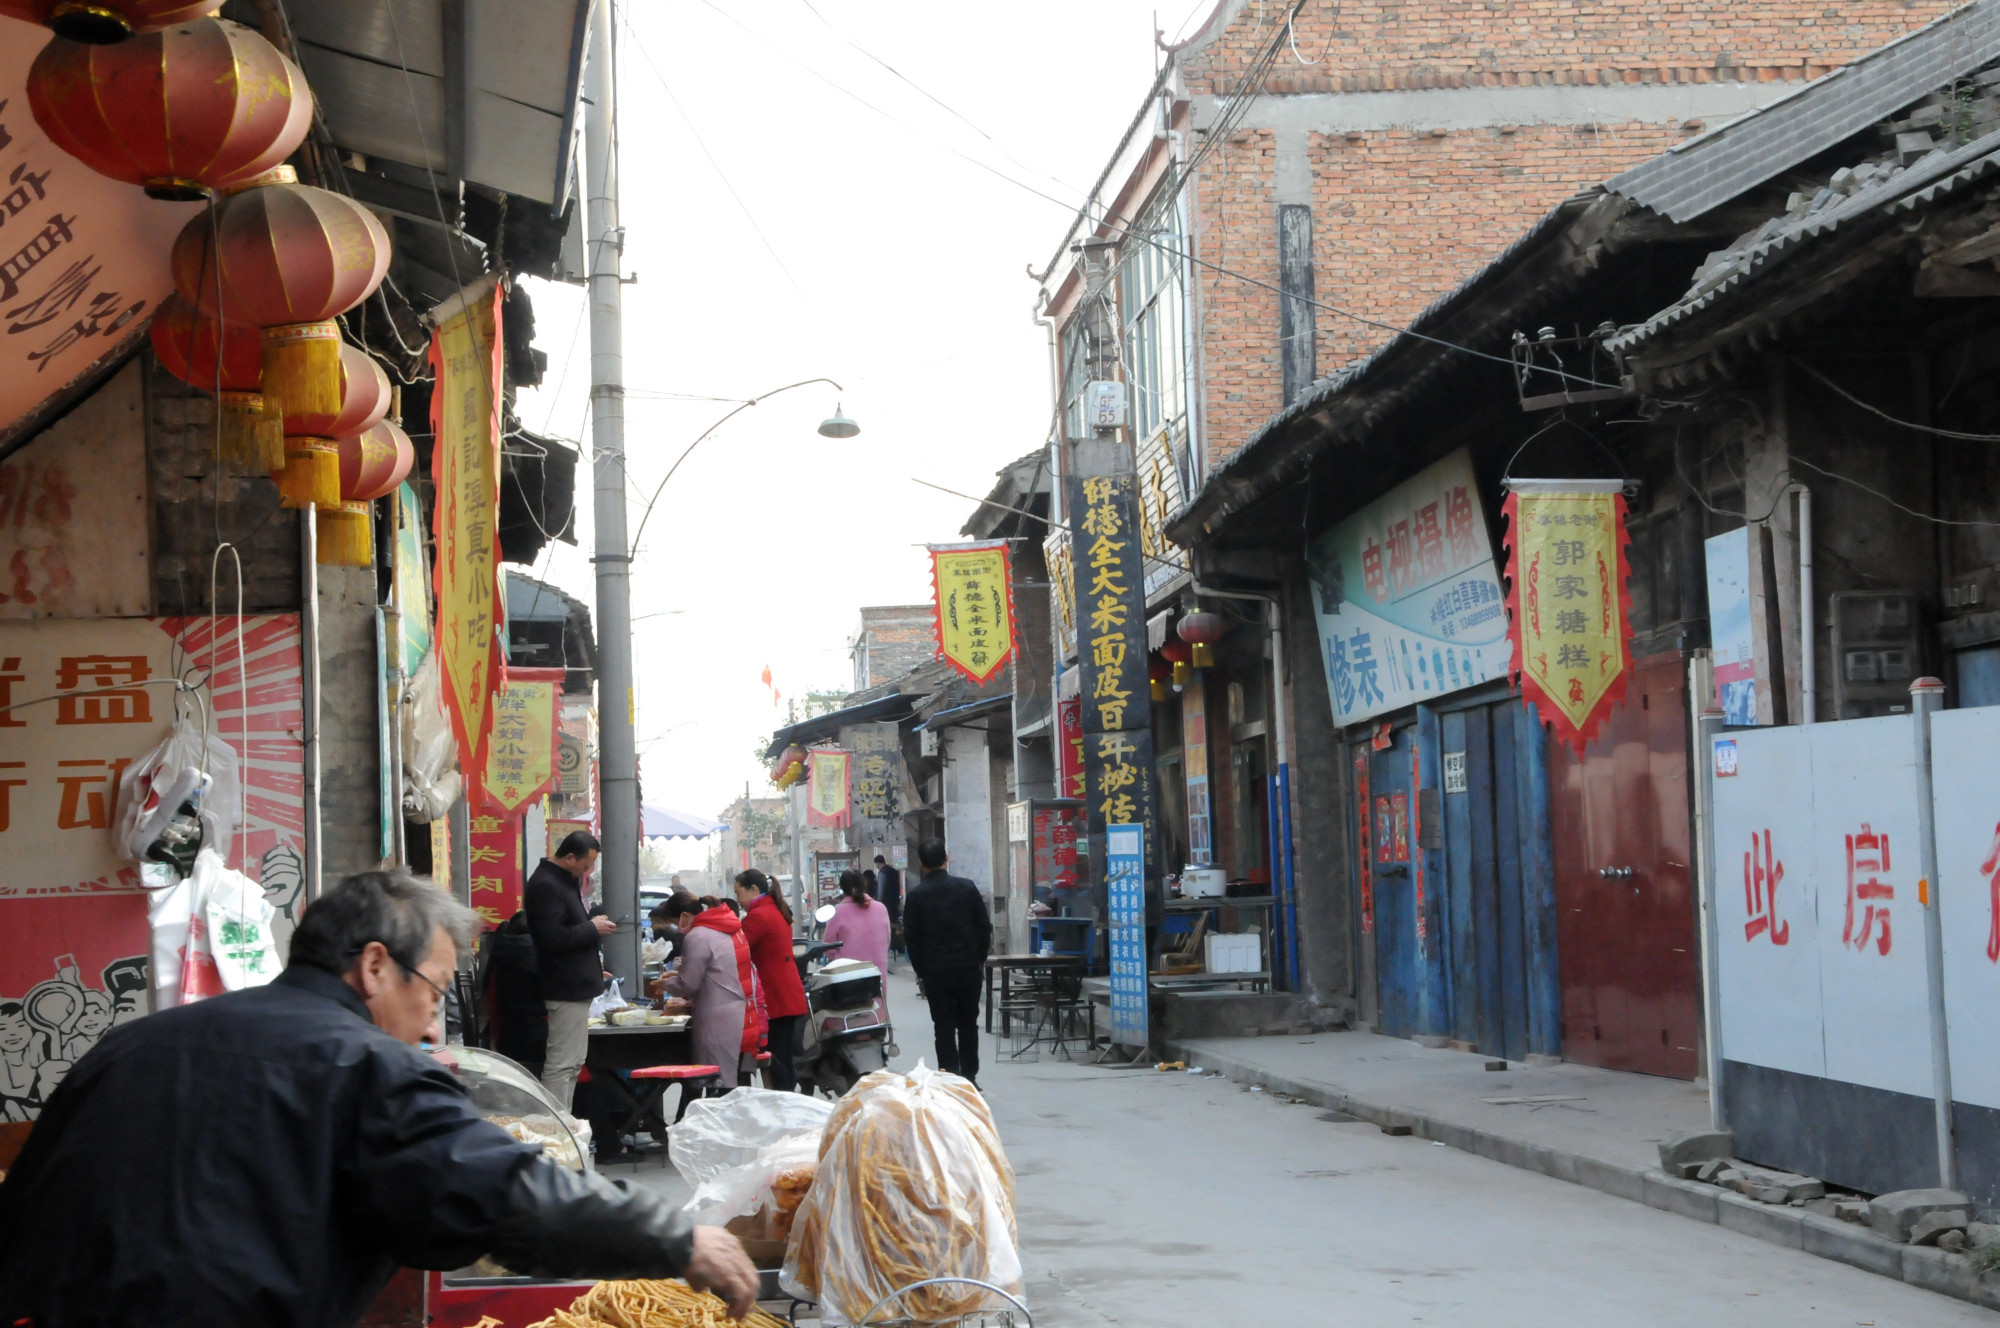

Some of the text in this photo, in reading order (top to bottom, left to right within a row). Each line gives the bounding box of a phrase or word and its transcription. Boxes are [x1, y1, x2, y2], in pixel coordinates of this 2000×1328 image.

[1099, 410, 1115, 424] 65
[1361, 486, 1480, 605] 电视摄像
[1551, 539, 1591, 669] 郭家糖糕
[1326, 627, 1384, 715] 修表
